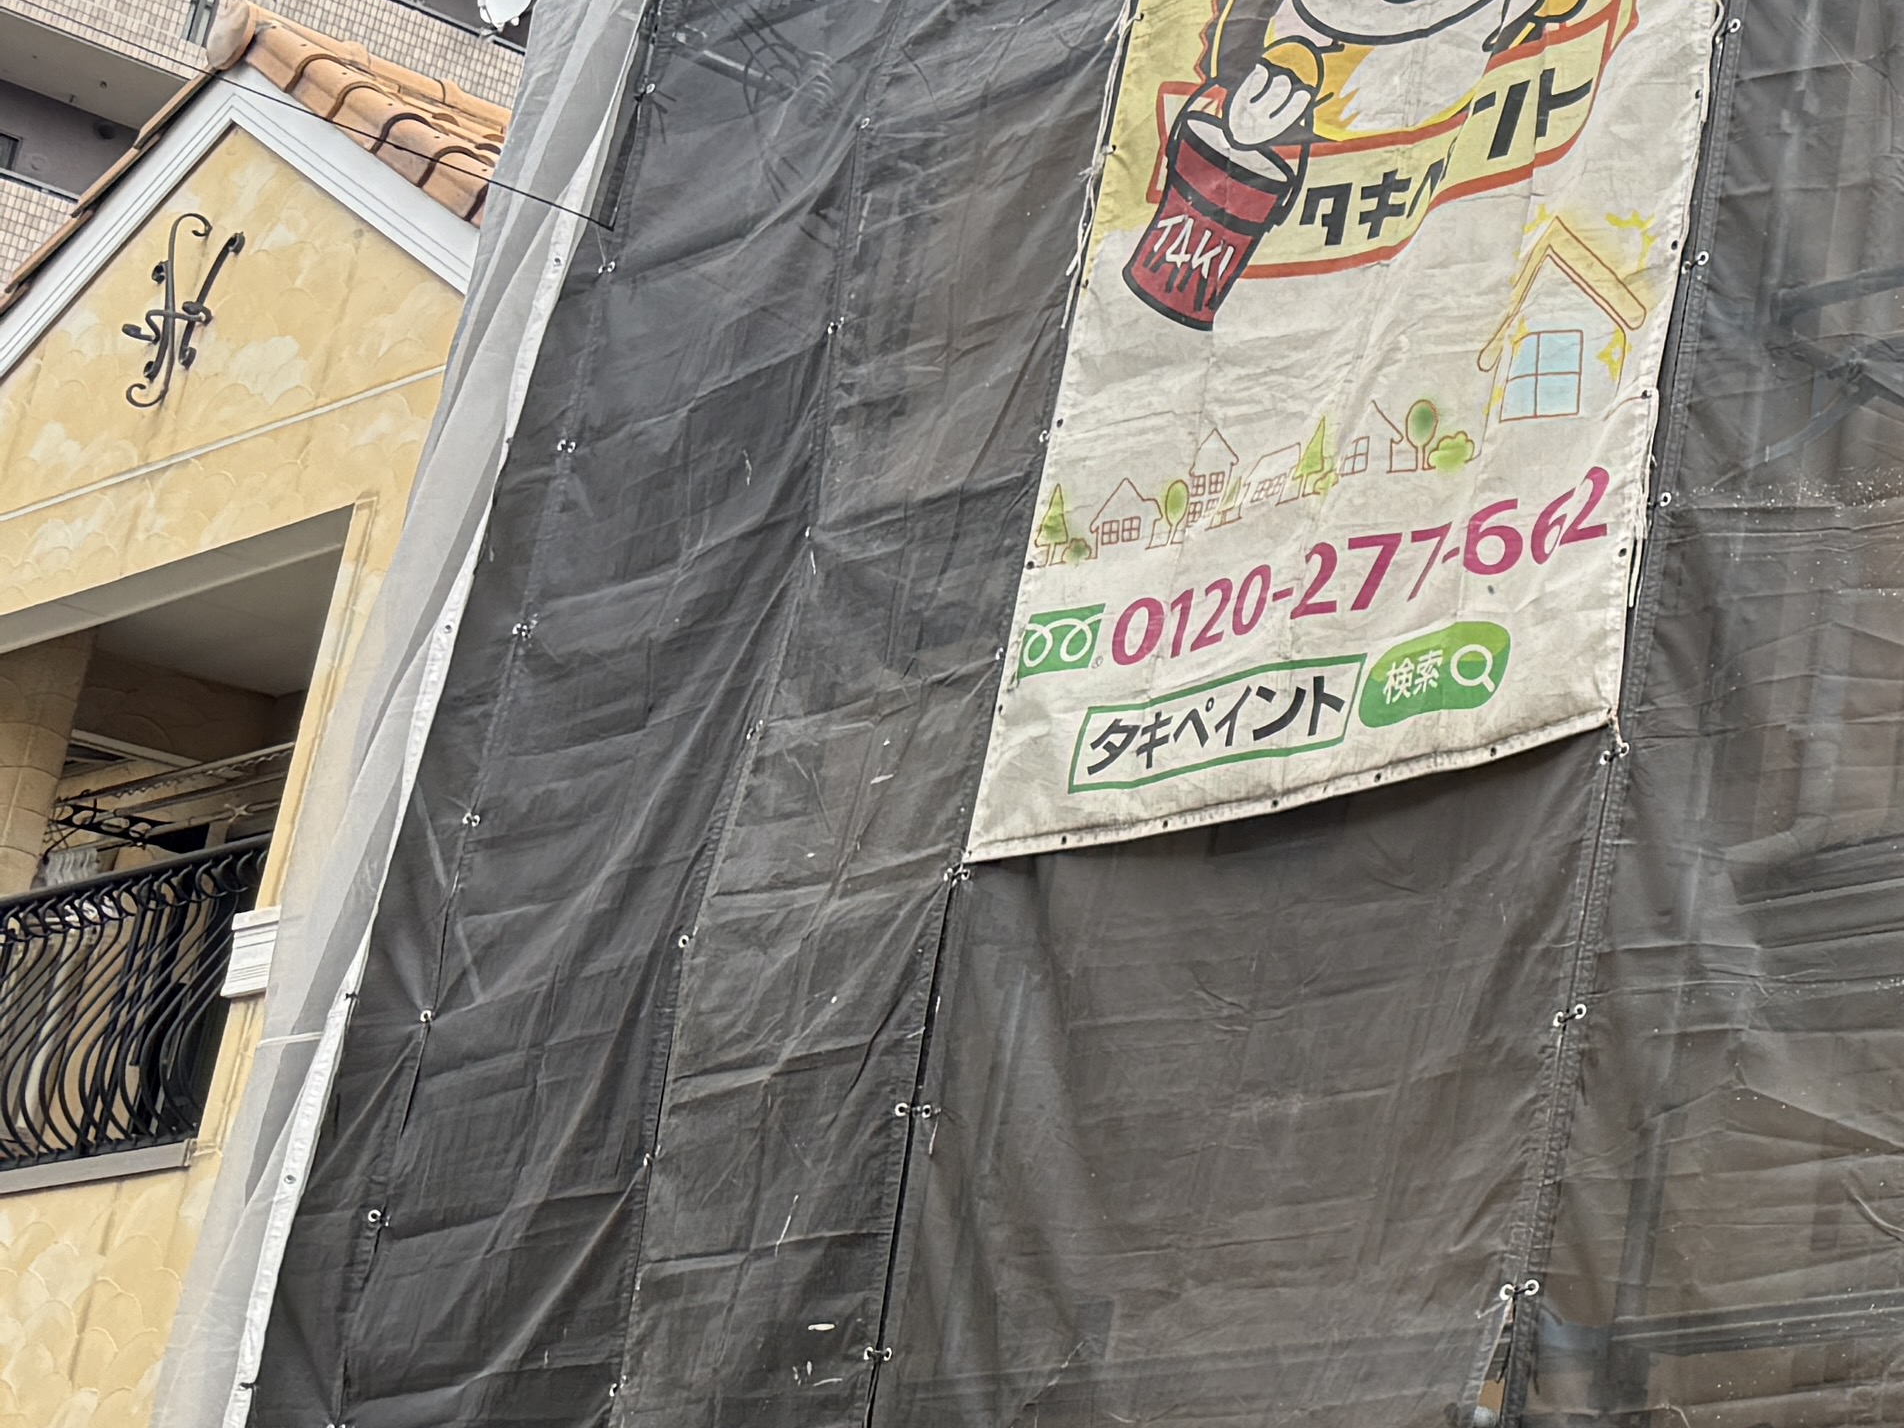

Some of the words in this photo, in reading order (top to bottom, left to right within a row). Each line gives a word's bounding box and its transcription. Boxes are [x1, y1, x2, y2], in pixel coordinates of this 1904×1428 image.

[1157, 214, 1235, 281] TAKI
[1110, 466, 1611, 667] 0120-277-662
[1384, 649, 1441, 705] 検索
[1087, 675, 1345, 775] タキペイント
